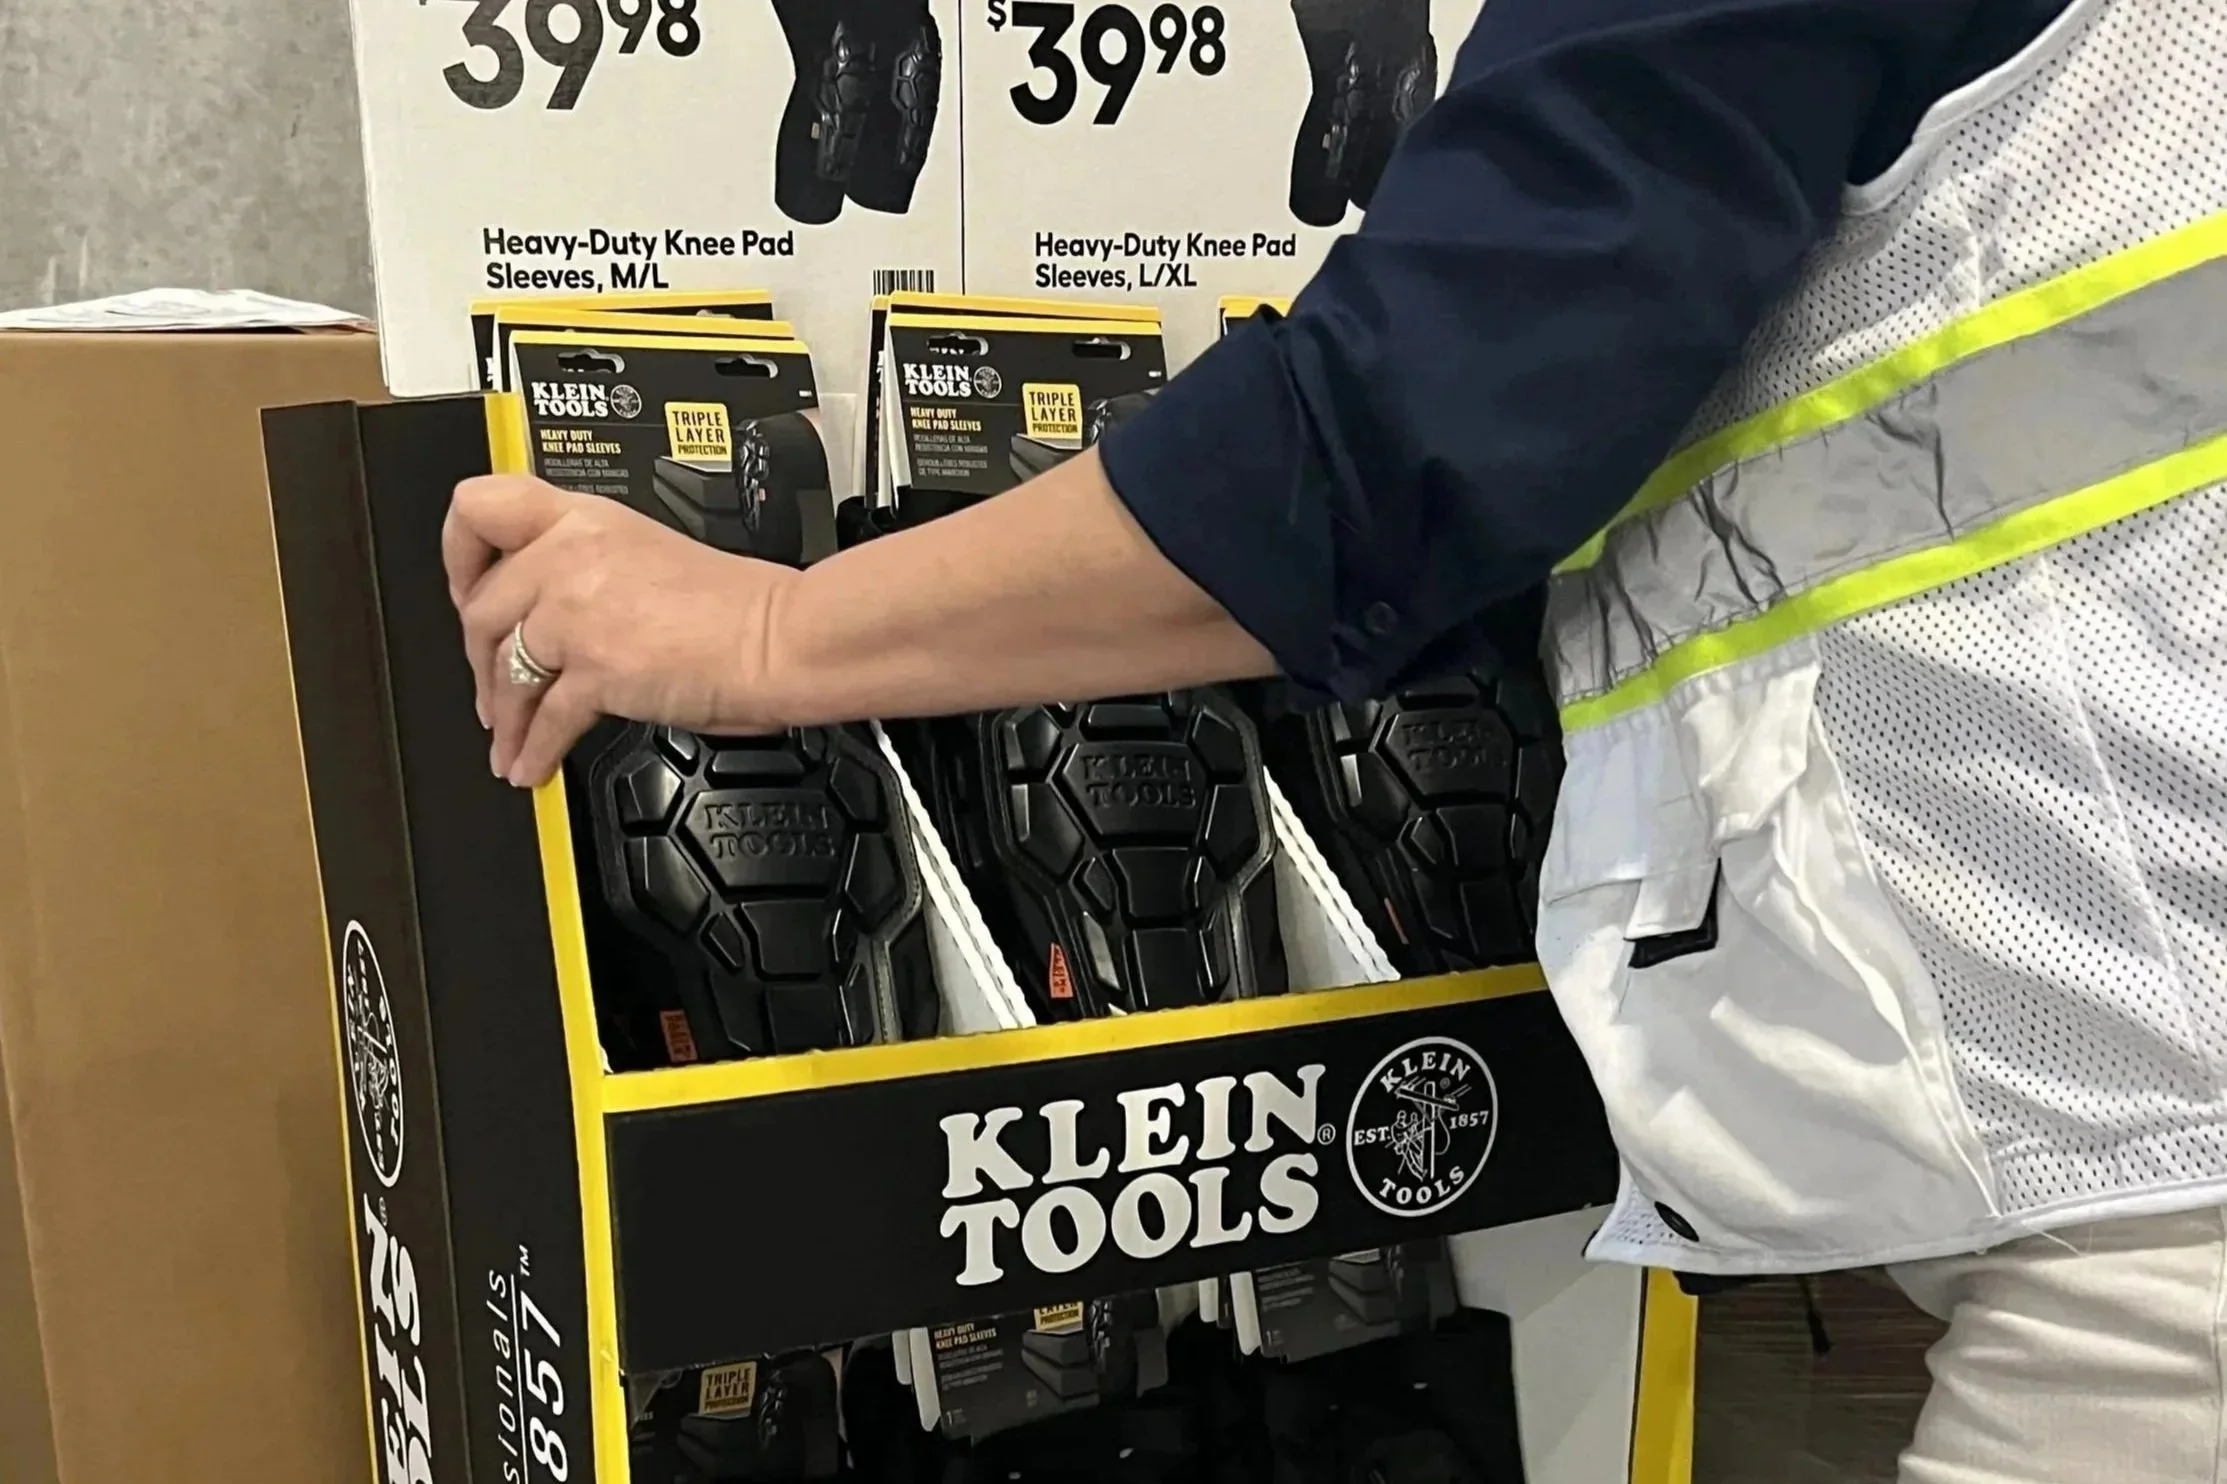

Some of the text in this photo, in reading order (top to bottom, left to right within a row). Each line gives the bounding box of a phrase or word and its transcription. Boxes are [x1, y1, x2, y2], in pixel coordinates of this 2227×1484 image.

[484, 229, 794, 260] Heavy-Duty Knee Pad
[1035, 232, 1296, 261] Heavy-Duty Knee Pad
[486, 262, 669, 293] Sleeves, M/L
[1035, 263, 1197, 291] Sleeves, L/XL
[902, 363, 970, 381] KLEIN
[531, 382, 606, 401] KLEIN
[905, 379, 972, 397] TOOLS
[534, 399, 609, 417] TOOLS
[1029, 391, 1075, 406] TRIPLE
[672, 411, 723, 426] TRIPLE
[910, 407, 957, 419] HEAVY DUTY
[1031, 407, 1077, 422] LAYER
[540, 429, 593, 441] HEAVY DUTY
[675, 427, 725, 443] LAYER
[912, 419, 982, 432] KNEE PAD SLEEVES
[542, 442, 622, 454] KNEE PAD SLEEVES
[678, 444, 728, 455] PROTECTION
[704, 803, 830, 829] KLEIN
[709, 833, 835, 859] TOOLS
[1380, 1051, 1471, 1093] KLEIN
[1353, 1110, 1489, 1145] EST. 1857
[1379, 1166, 1464, 1204] TOOLS
[939, 1152, 1319, 1286] TOOLS
[707, 1368, 752, 1387] TRIPLE
[705, 1382, 750, 1401] LAYER
